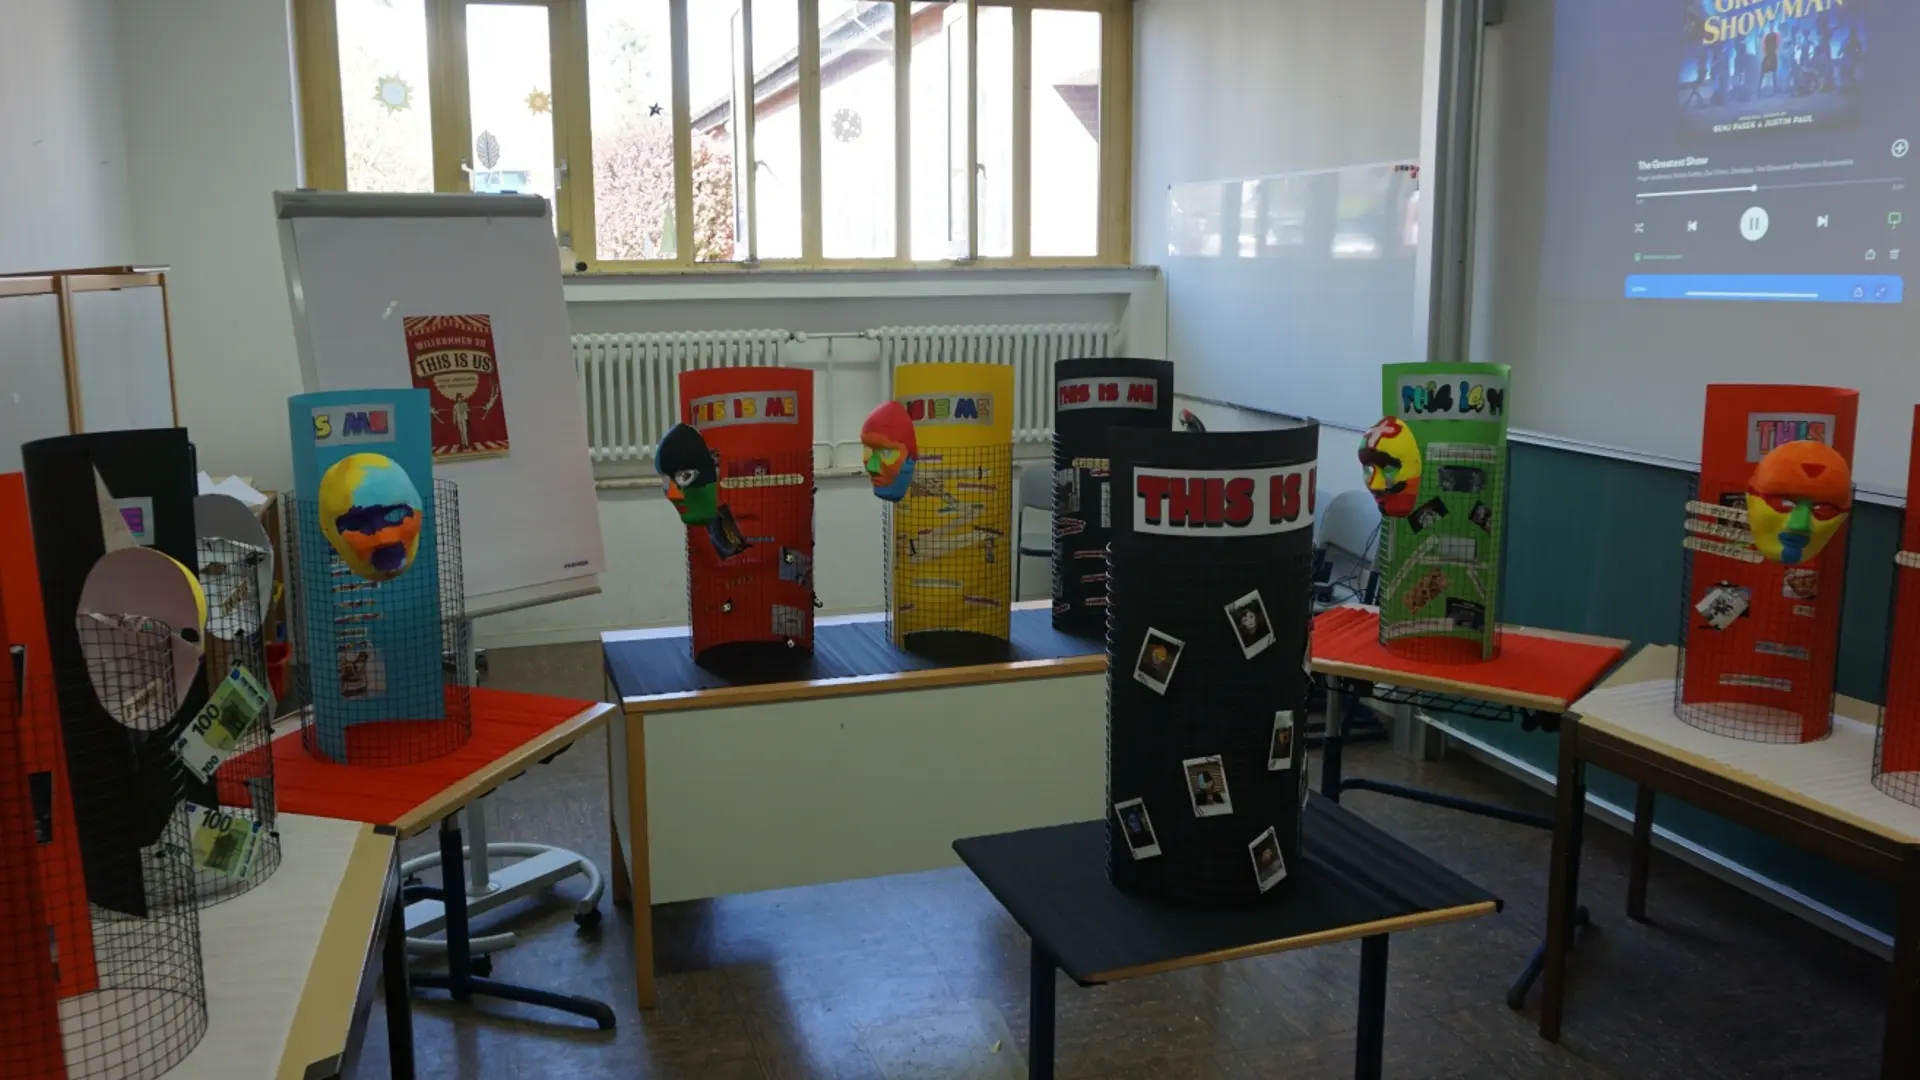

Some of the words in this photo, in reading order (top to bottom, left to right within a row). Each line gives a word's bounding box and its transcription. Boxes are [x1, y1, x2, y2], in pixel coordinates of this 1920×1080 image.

[417, 352, 451, 375] THIS
[454, 352, 468, 368] IS
[472, 354, 490, 371] US
[766, 397, 795, 416] ME
[1137, 474, 1255, 528] THIS
[1269, 472, 1302, 525] IS
[191, 703, 221, 737] 100
[201, 755, 219, 777] 100
[201, 809, 233, 833] 100
